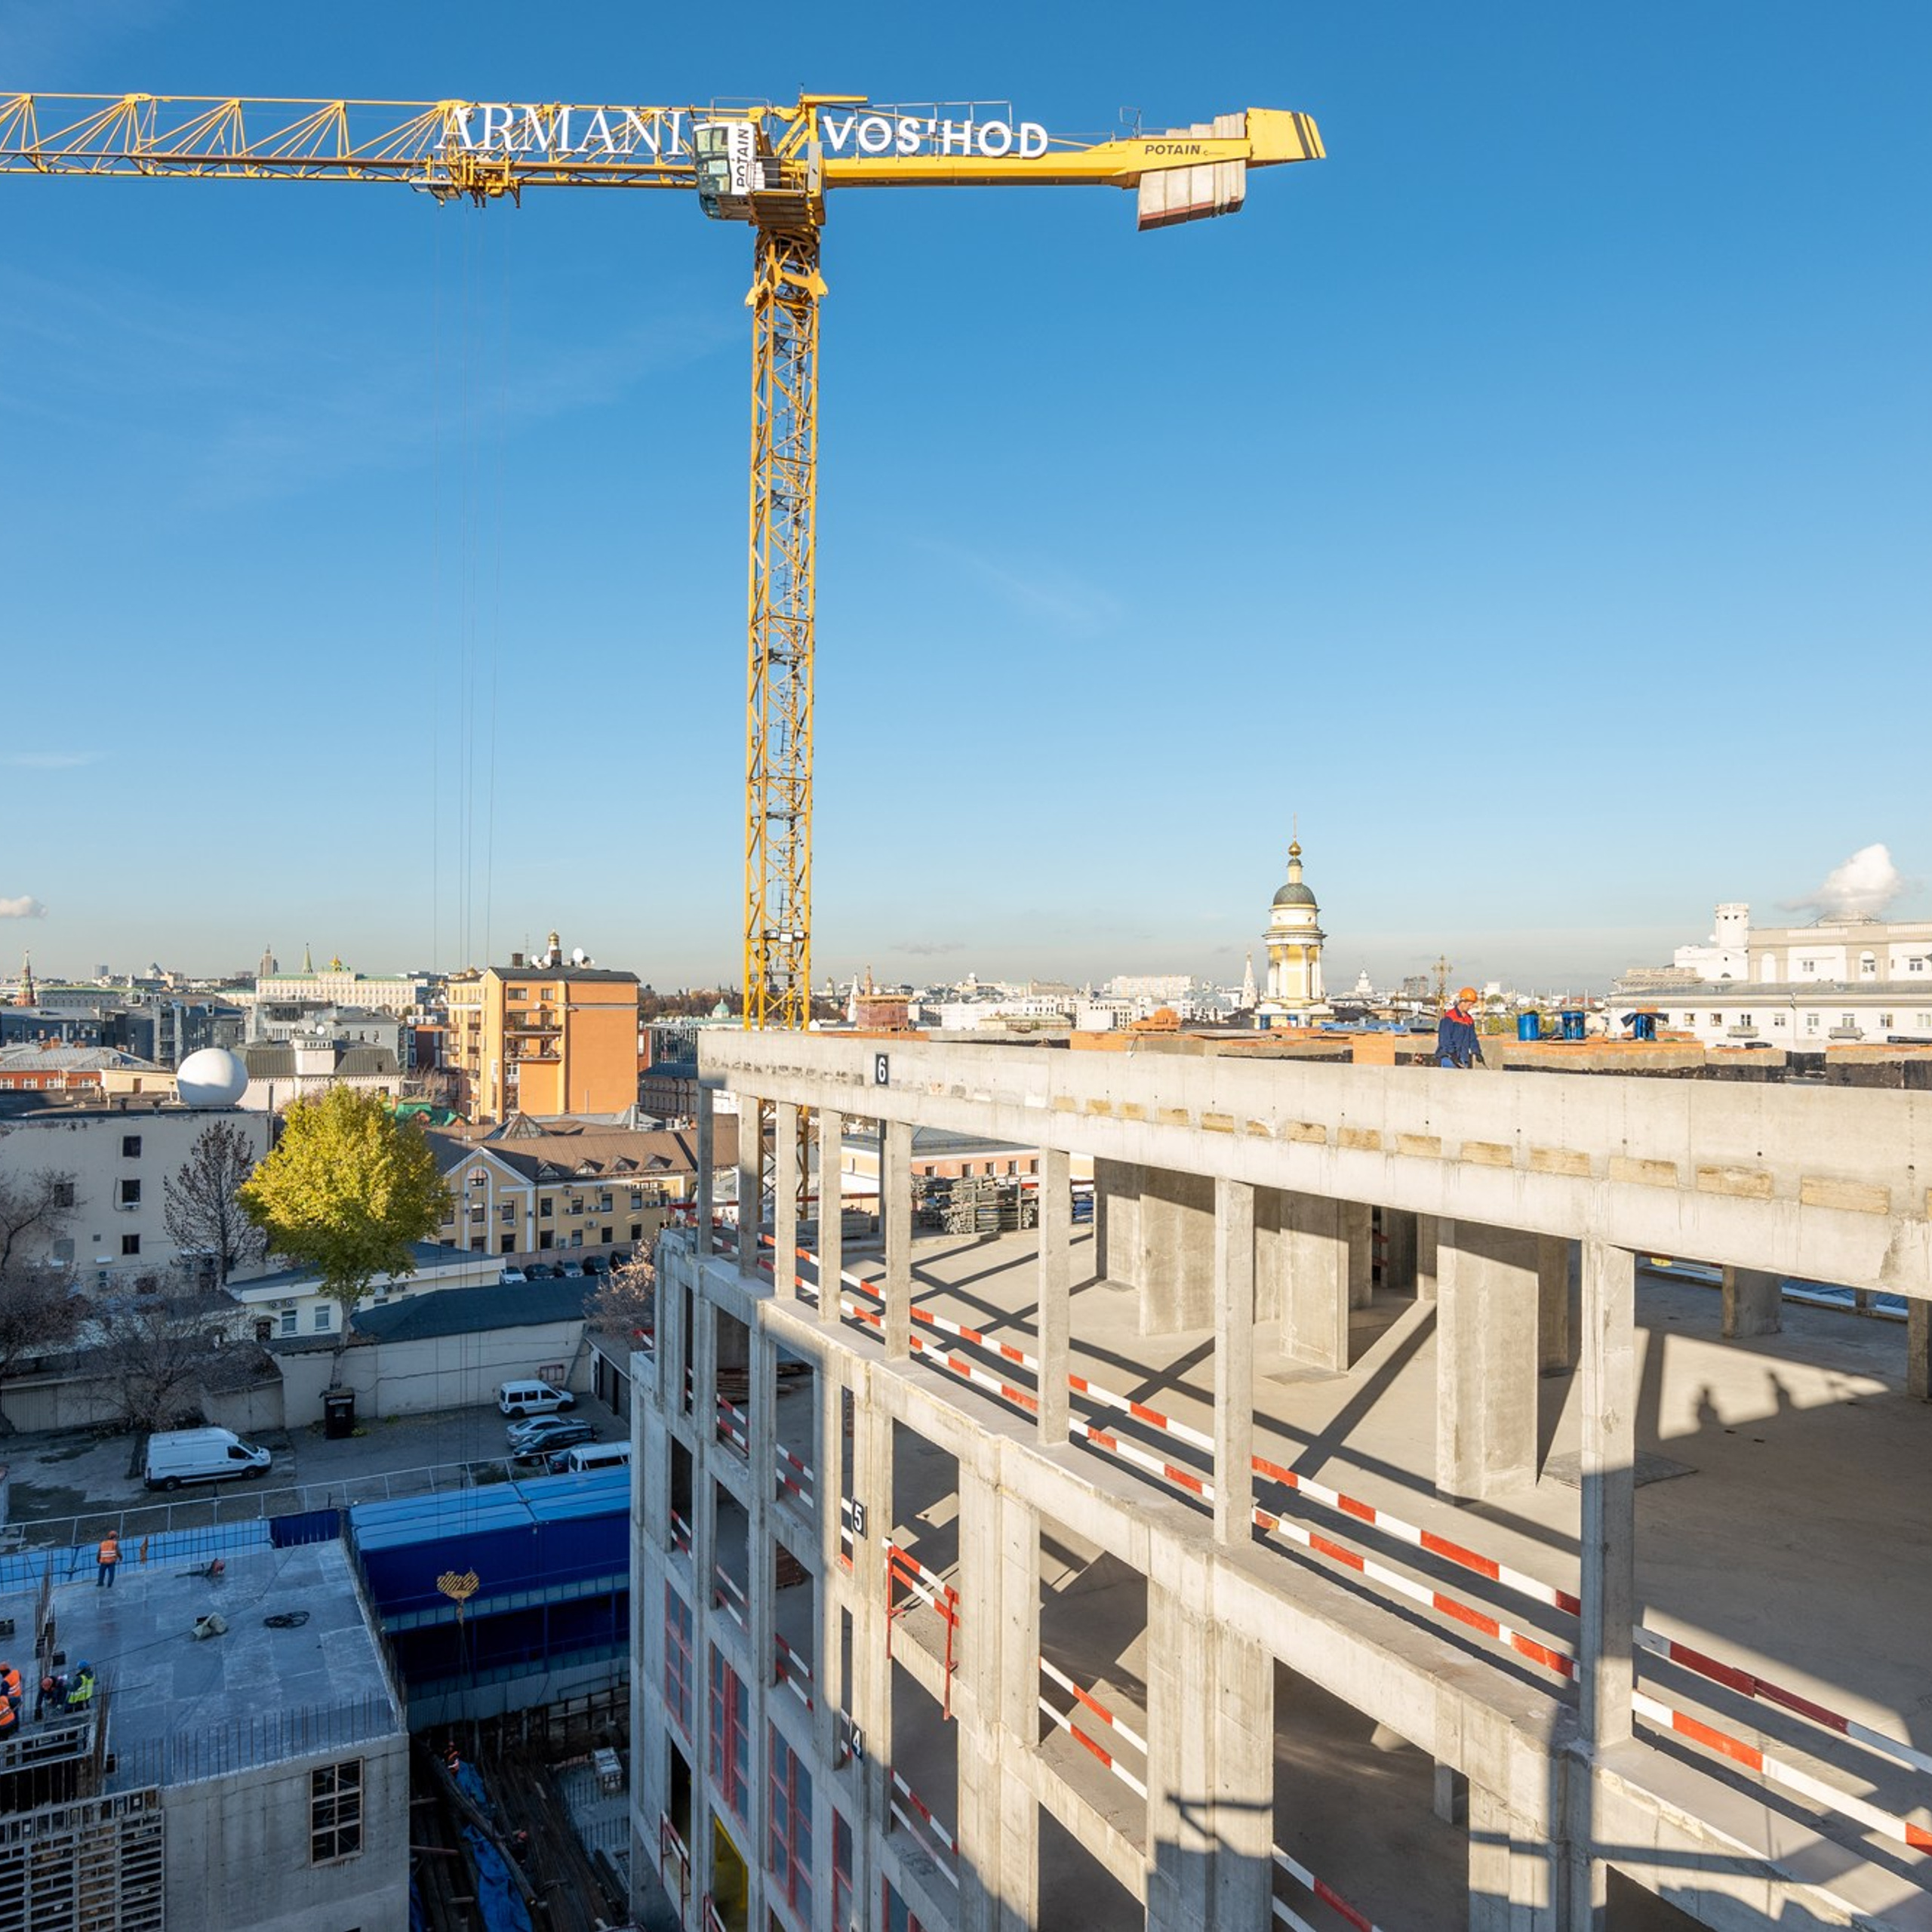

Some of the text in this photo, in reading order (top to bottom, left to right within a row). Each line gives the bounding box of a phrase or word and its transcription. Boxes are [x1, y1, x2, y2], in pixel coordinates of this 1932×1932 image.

[434, 105, 685, 156] ARMANI
[737, 128, 749, 187] POTAIN
[1144, 144, 1201, 155] POTAIN
[878, 1056, 887, 1083] 6
[854, 1503, 863, 1532] 5
[852, 1729, 861, 1756] 4
